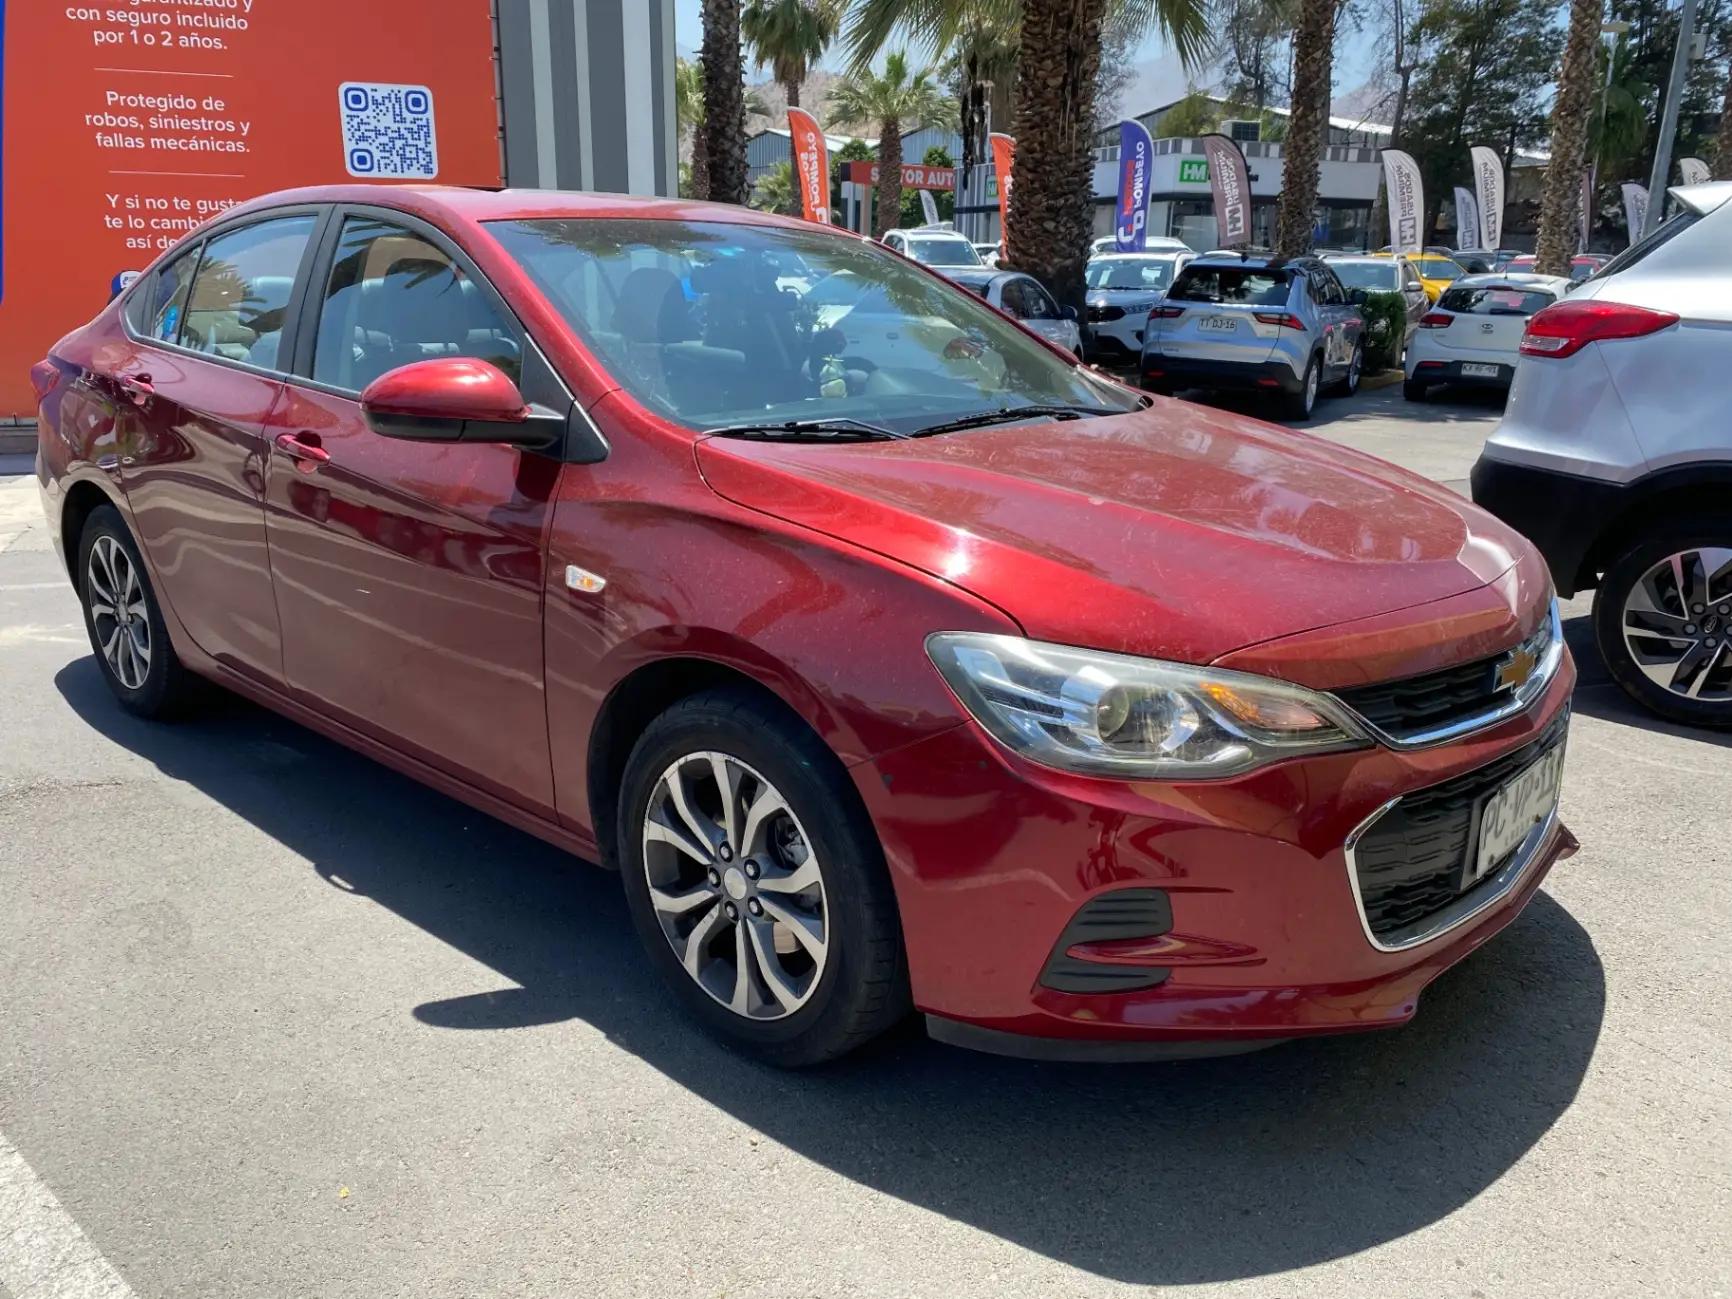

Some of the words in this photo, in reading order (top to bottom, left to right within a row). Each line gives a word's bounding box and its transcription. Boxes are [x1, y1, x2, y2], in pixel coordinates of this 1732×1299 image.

[65, 7, 101, 21] con
[106, 9, 171, 27] seguro
[176, 10, 248, 30] incluido
[93, 30, 124, 46] por
[130, 29, 138, 44] 1
[143, 33, 155, 46] o
[160, 31, 173, 46] 2
[179, 32, 228, 50] años.
[106, 90, 197, 112] Protegido
[202, 96, 225, 111] de
[85, 111, 144, 131] robos,
[148, 113, 236, 132] siniestros
[240, 121, 250, 136] y
[95, 132, 145, 148] fallas
[150, 135, 250, 153] mecánicas.
[105, 193, 120, 209] Y
[125, 194, 140, 210] si
[145, 197, 169, 210] no
[173, 196, 191, 211] te
[104, 214, 123, 229] te
[128, 214, 145, 229] lo
[126, 234, 151, 249] así
